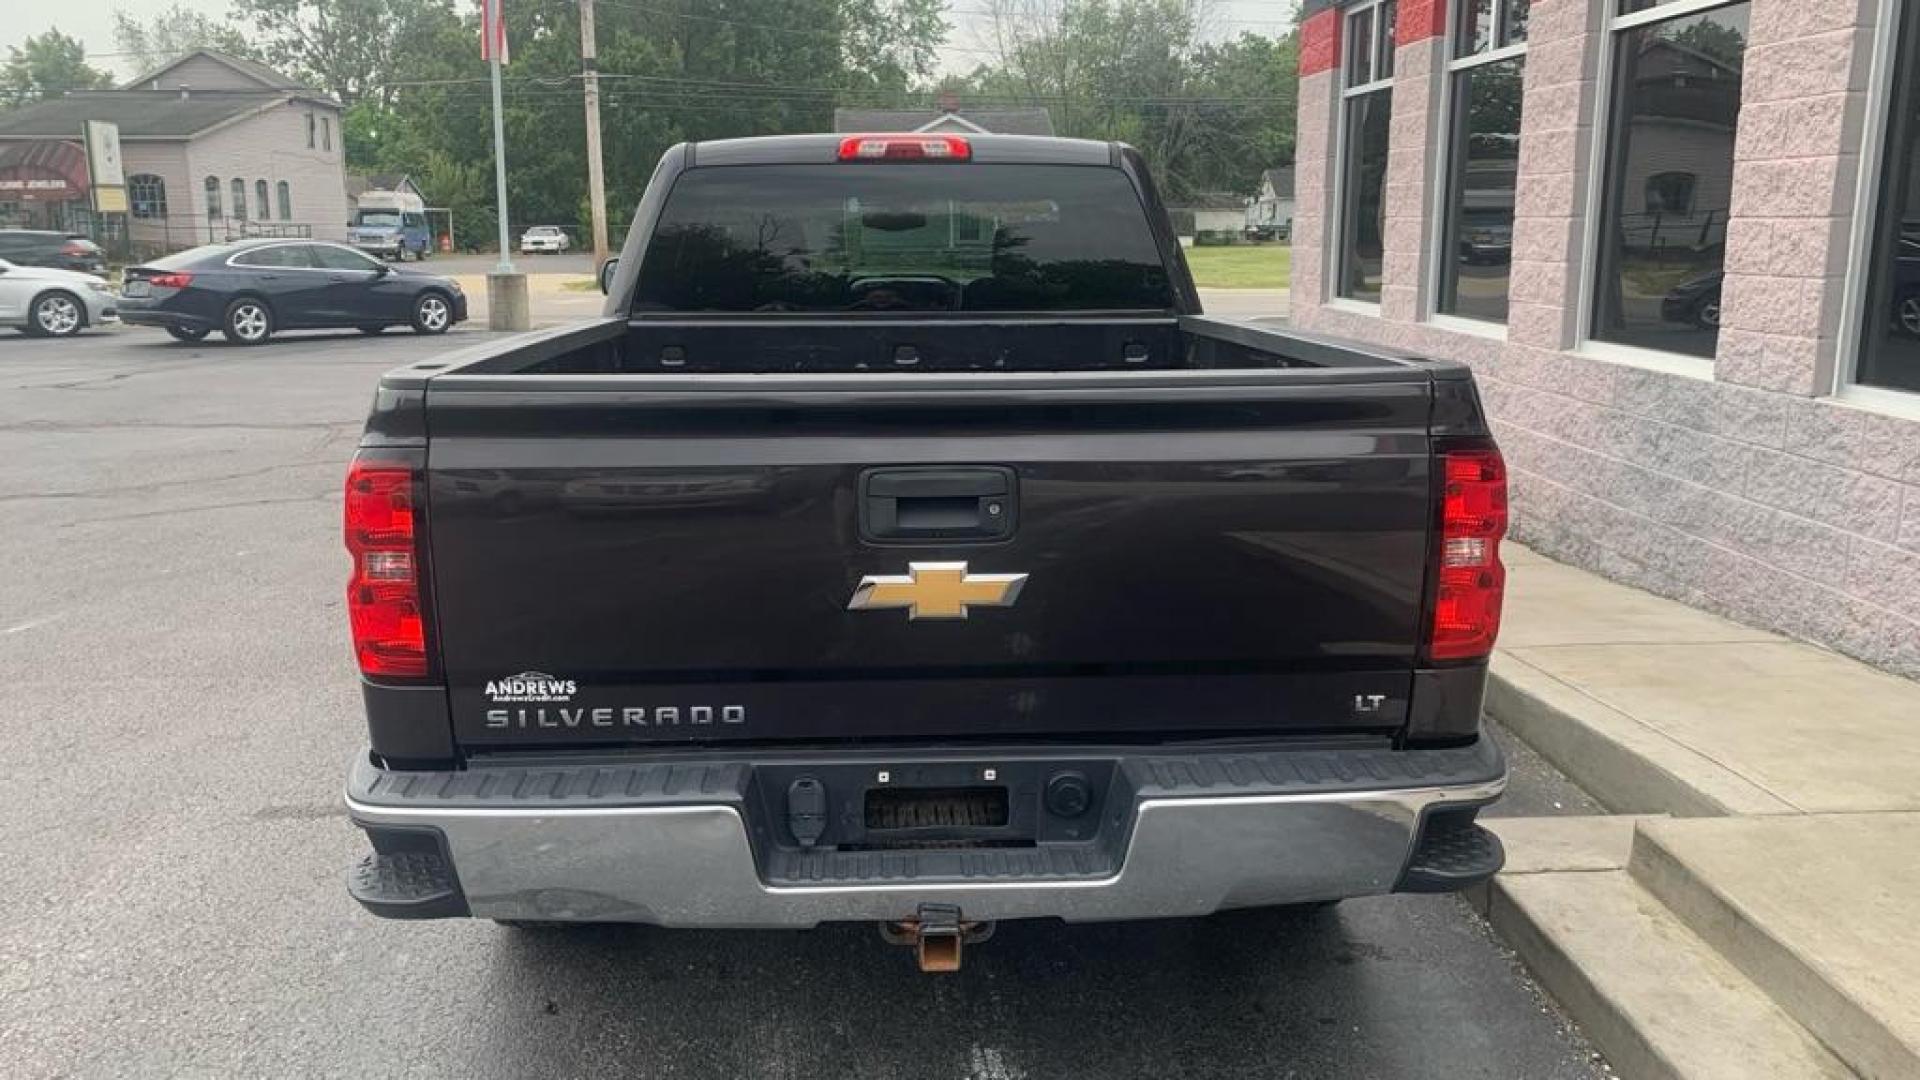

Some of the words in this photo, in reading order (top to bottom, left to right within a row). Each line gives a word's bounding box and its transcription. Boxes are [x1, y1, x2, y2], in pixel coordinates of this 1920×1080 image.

[485, 680, 576, 695] ANDREWS
[1355, 695, 1386, 712] LT
[486, 705, 745, 727] SILVERADO
